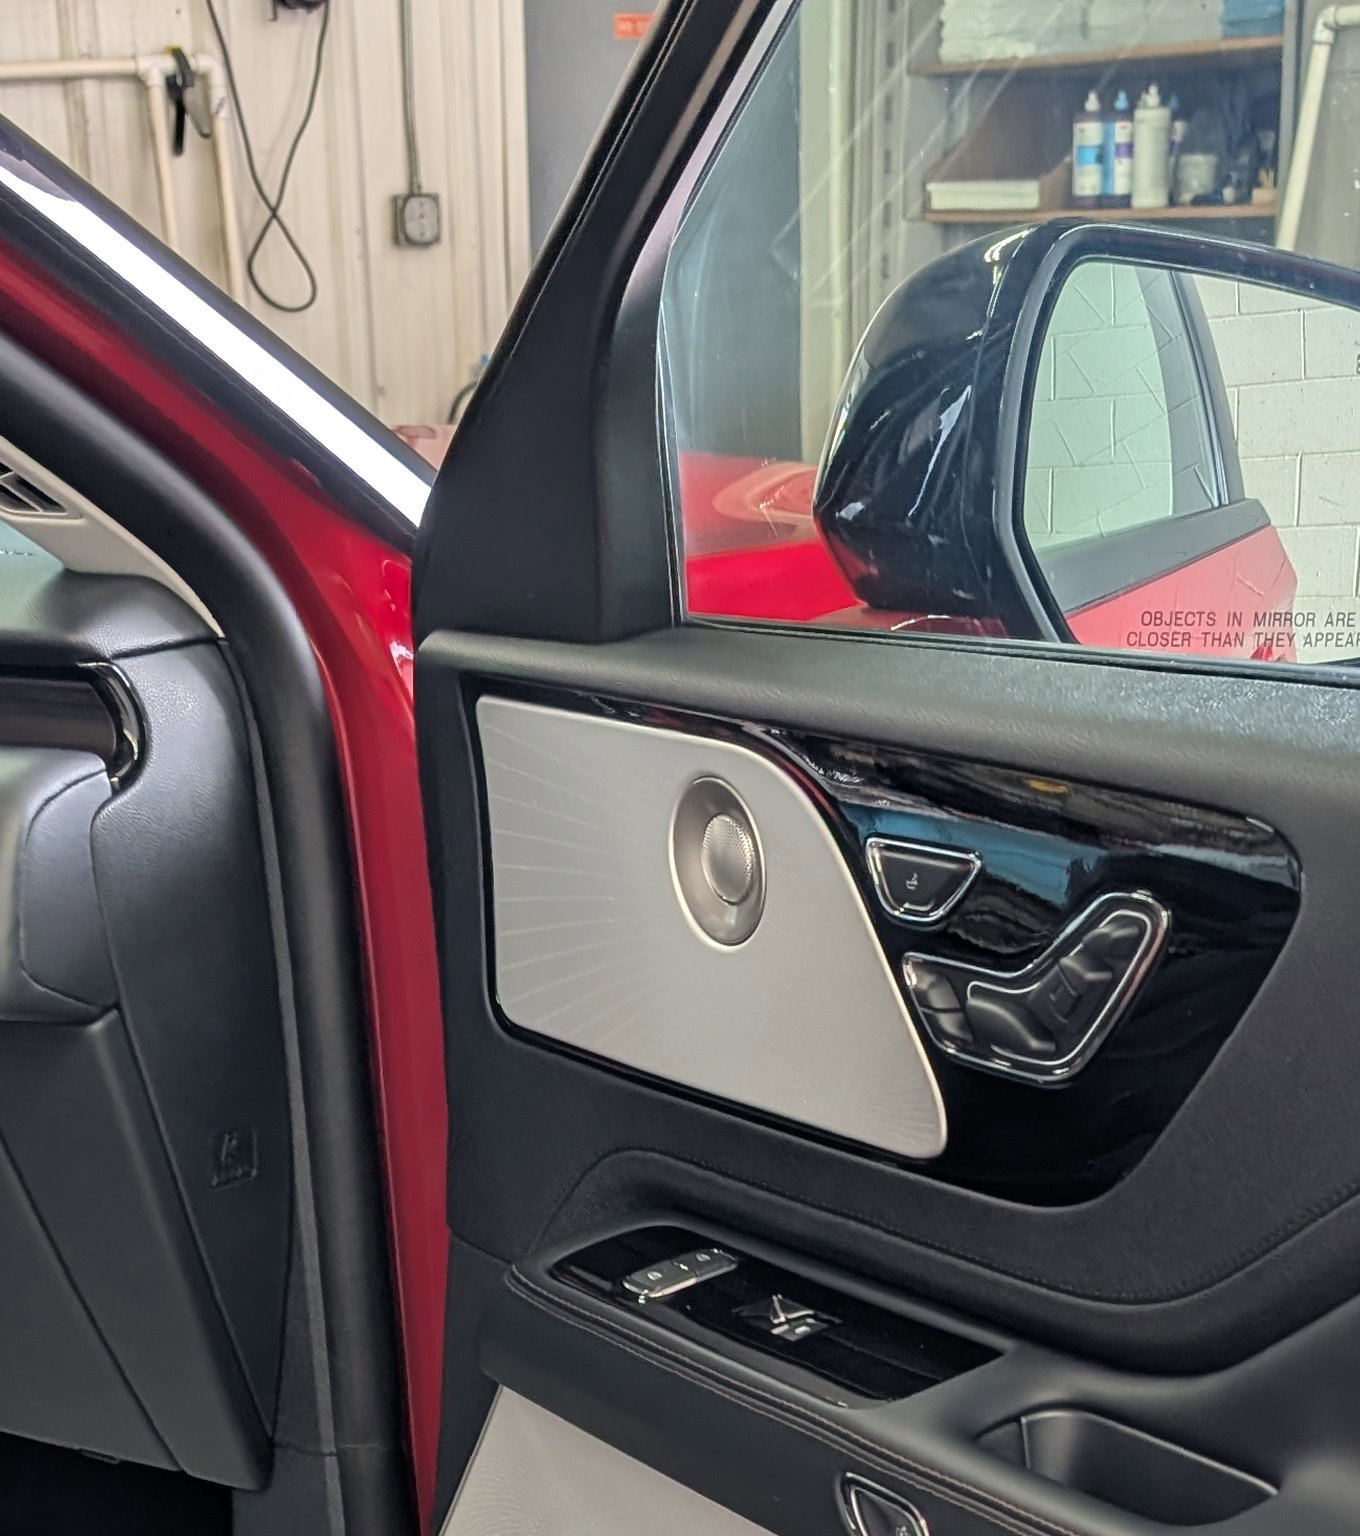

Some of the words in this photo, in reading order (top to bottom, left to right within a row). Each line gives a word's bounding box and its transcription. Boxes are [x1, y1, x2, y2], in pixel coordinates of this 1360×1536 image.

[1141, 611, 1217, 627] OBJECTS
[1226, 612, 1242, 627] IN
[1253, 612, 1316, 627] MIRROR
[1324, 612, 1357, 627] ARE
[1126, 631, 1191, 647] CLOSER
[1202, 632, 1245, 647] THAN
[1254, 632, 1297, 647] THEY
